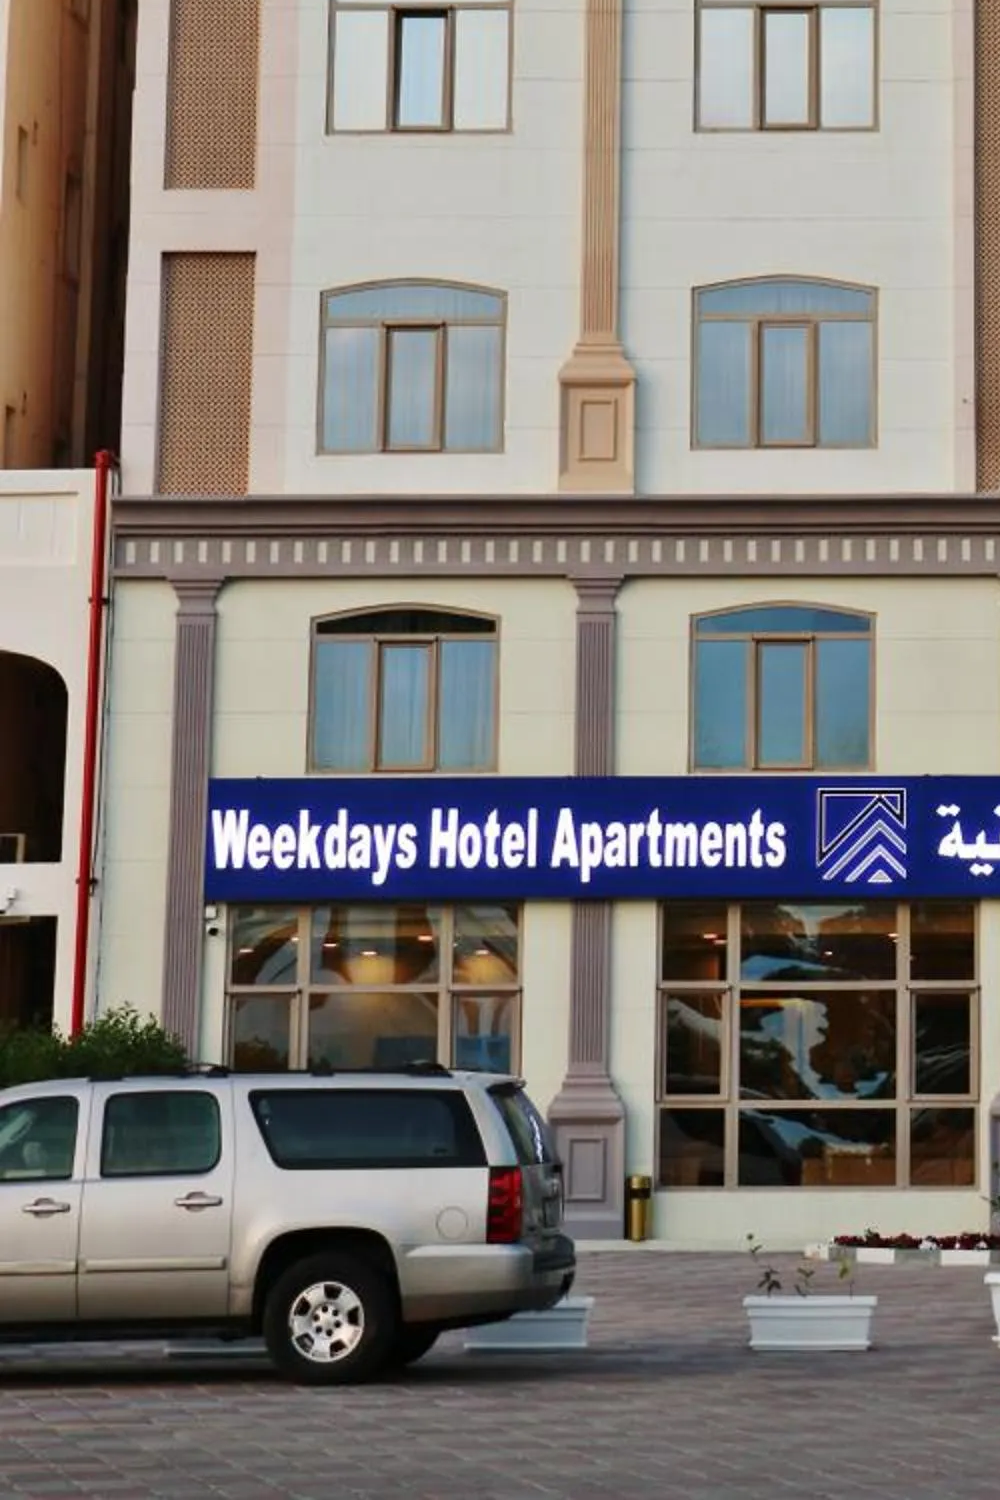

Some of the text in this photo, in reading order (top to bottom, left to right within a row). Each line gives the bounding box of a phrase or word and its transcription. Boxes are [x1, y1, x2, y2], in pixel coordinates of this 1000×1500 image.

[211, 807, 787, 886] Weekdays Hotel Apartments
